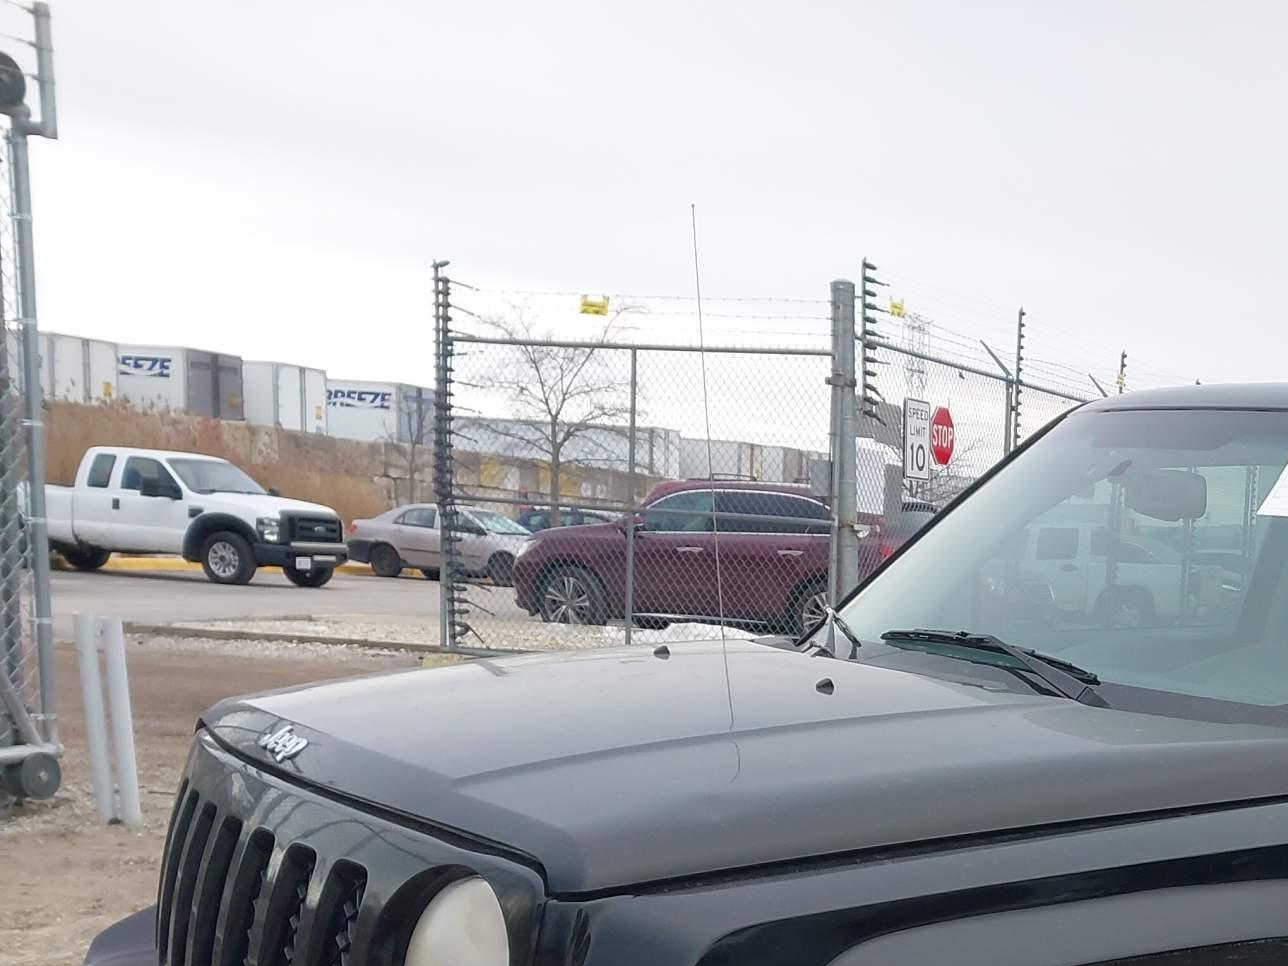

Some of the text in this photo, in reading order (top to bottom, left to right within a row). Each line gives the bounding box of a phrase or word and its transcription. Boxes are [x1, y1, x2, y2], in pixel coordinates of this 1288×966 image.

[908, 407, 928, 421] SPEED
[909, 424, 926, 437] LIMIT
[932, 424, 953, 449] STOP
[910, 442, 926, 472] 10
[258, 725, 308, 762] Jeep
